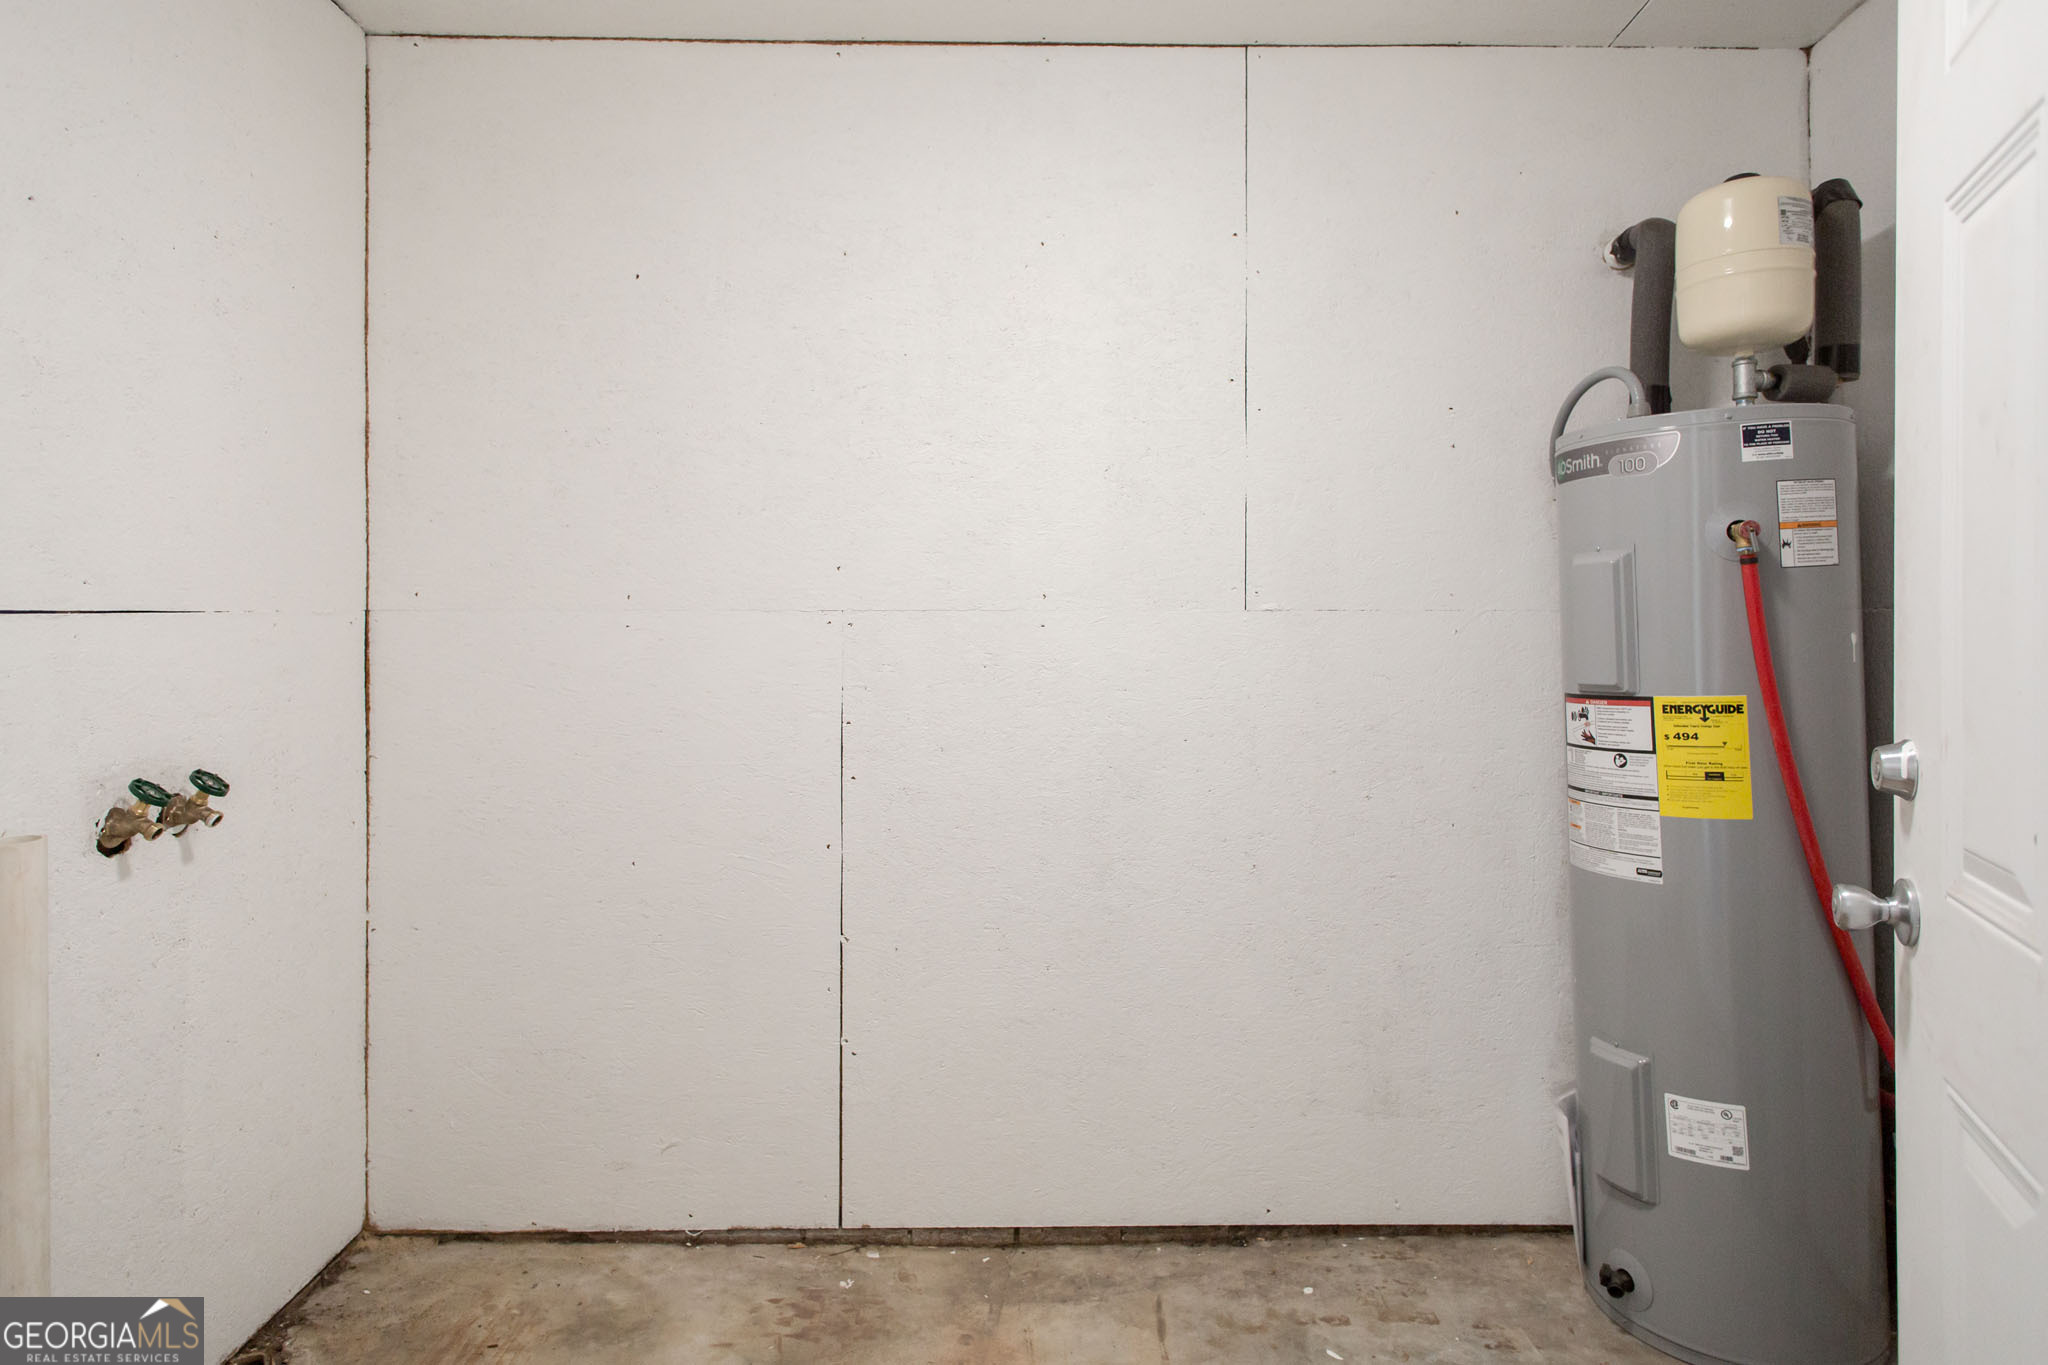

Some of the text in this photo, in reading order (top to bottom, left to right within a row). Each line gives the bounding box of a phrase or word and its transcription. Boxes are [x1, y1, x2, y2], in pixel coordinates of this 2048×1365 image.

[1620, 456, 1646, 472] 100
[1662, 704, 1744, 715] ENERGYGUIDE
[1673, 732, 1699, 741] 494
